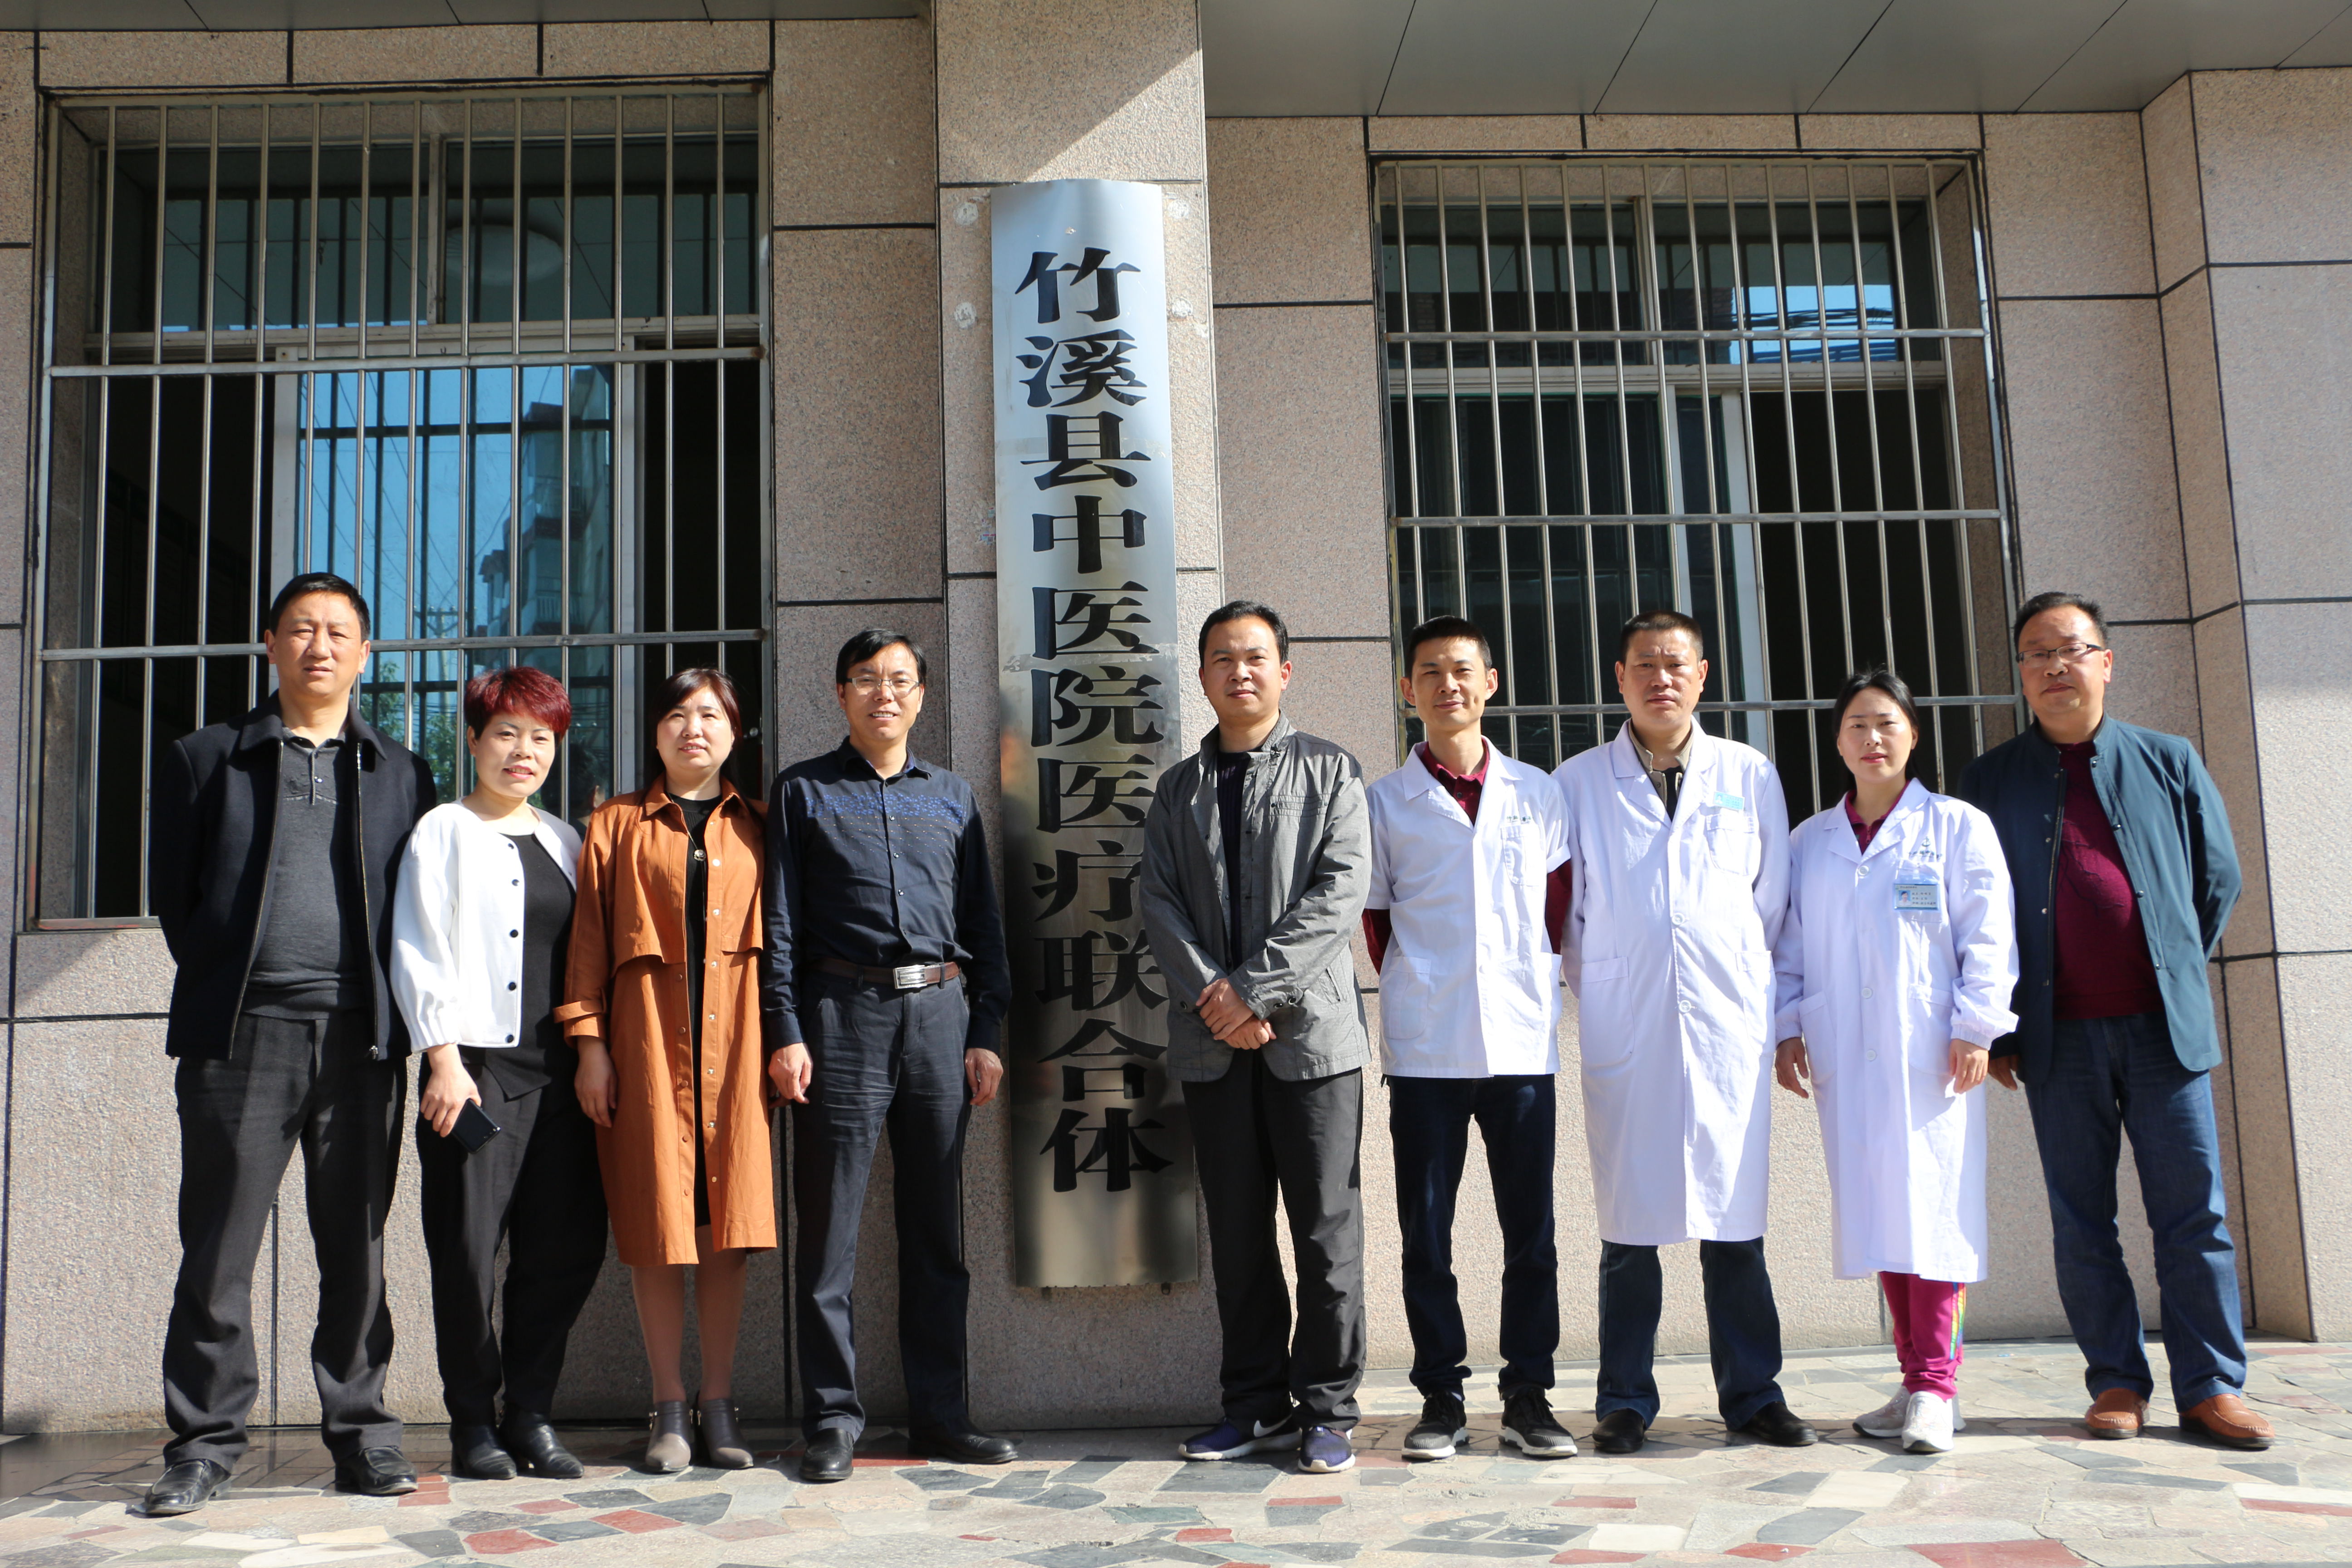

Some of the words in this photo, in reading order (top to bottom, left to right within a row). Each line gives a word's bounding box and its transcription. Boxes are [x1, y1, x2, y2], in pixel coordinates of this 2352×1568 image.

[1014, 247, 1174, 1192] 竹溪县中医院医疗联合体
